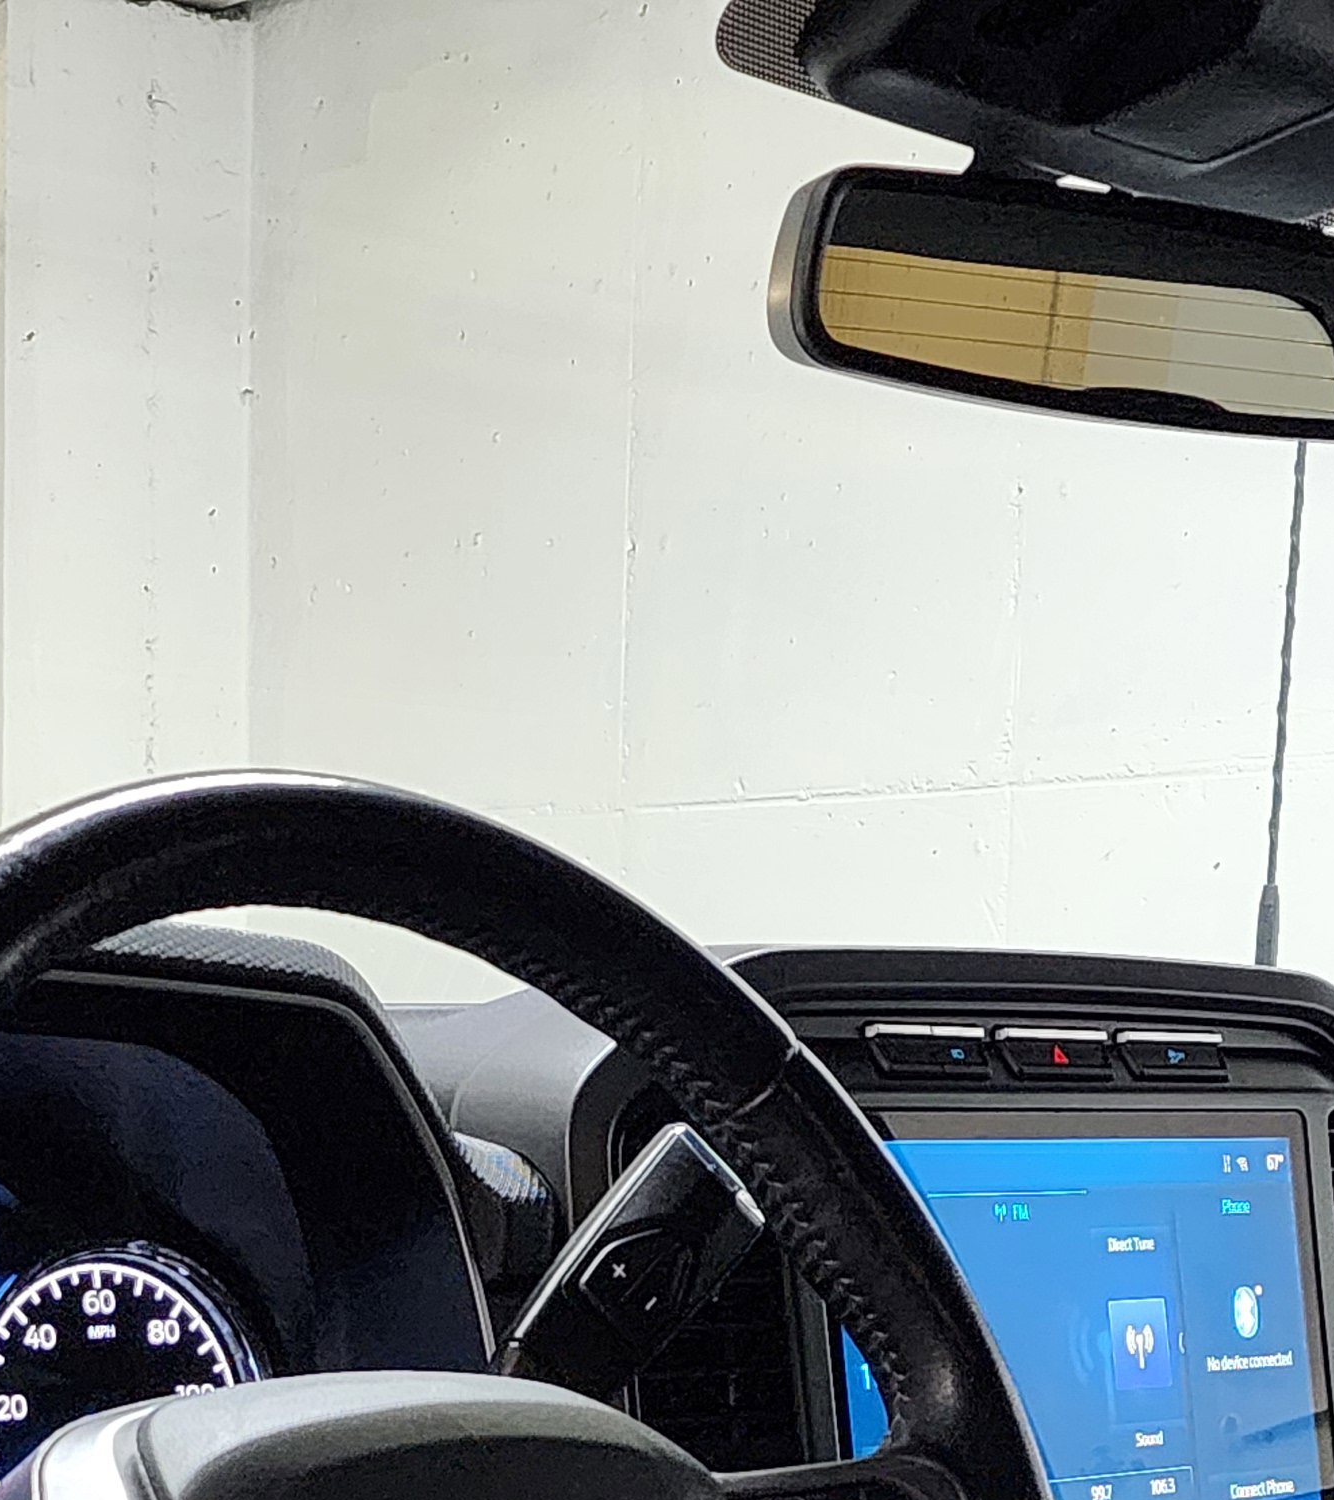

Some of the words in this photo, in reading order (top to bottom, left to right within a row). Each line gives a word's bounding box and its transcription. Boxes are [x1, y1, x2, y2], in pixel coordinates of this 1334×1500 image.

[1221, 1199, 1251, 1215] Phone
[1107, 1236, 1133, 1252] Direct
[1133, 1236, 1155, 1251] Tune
[82, 1289, 116, 1315] 60
[23, 1323, 57, 1350] 40
[87, 1324, 116, 1340] MPH
[147, 1319, 180, 1345] 80
[1249, 1350, 1293, 1369] connected
[1135, 1430, 1164, 1448] Sound
[1230, 1481, 1266, 1499] Connect
[1266, 1479, 1295, 1495] Phone
